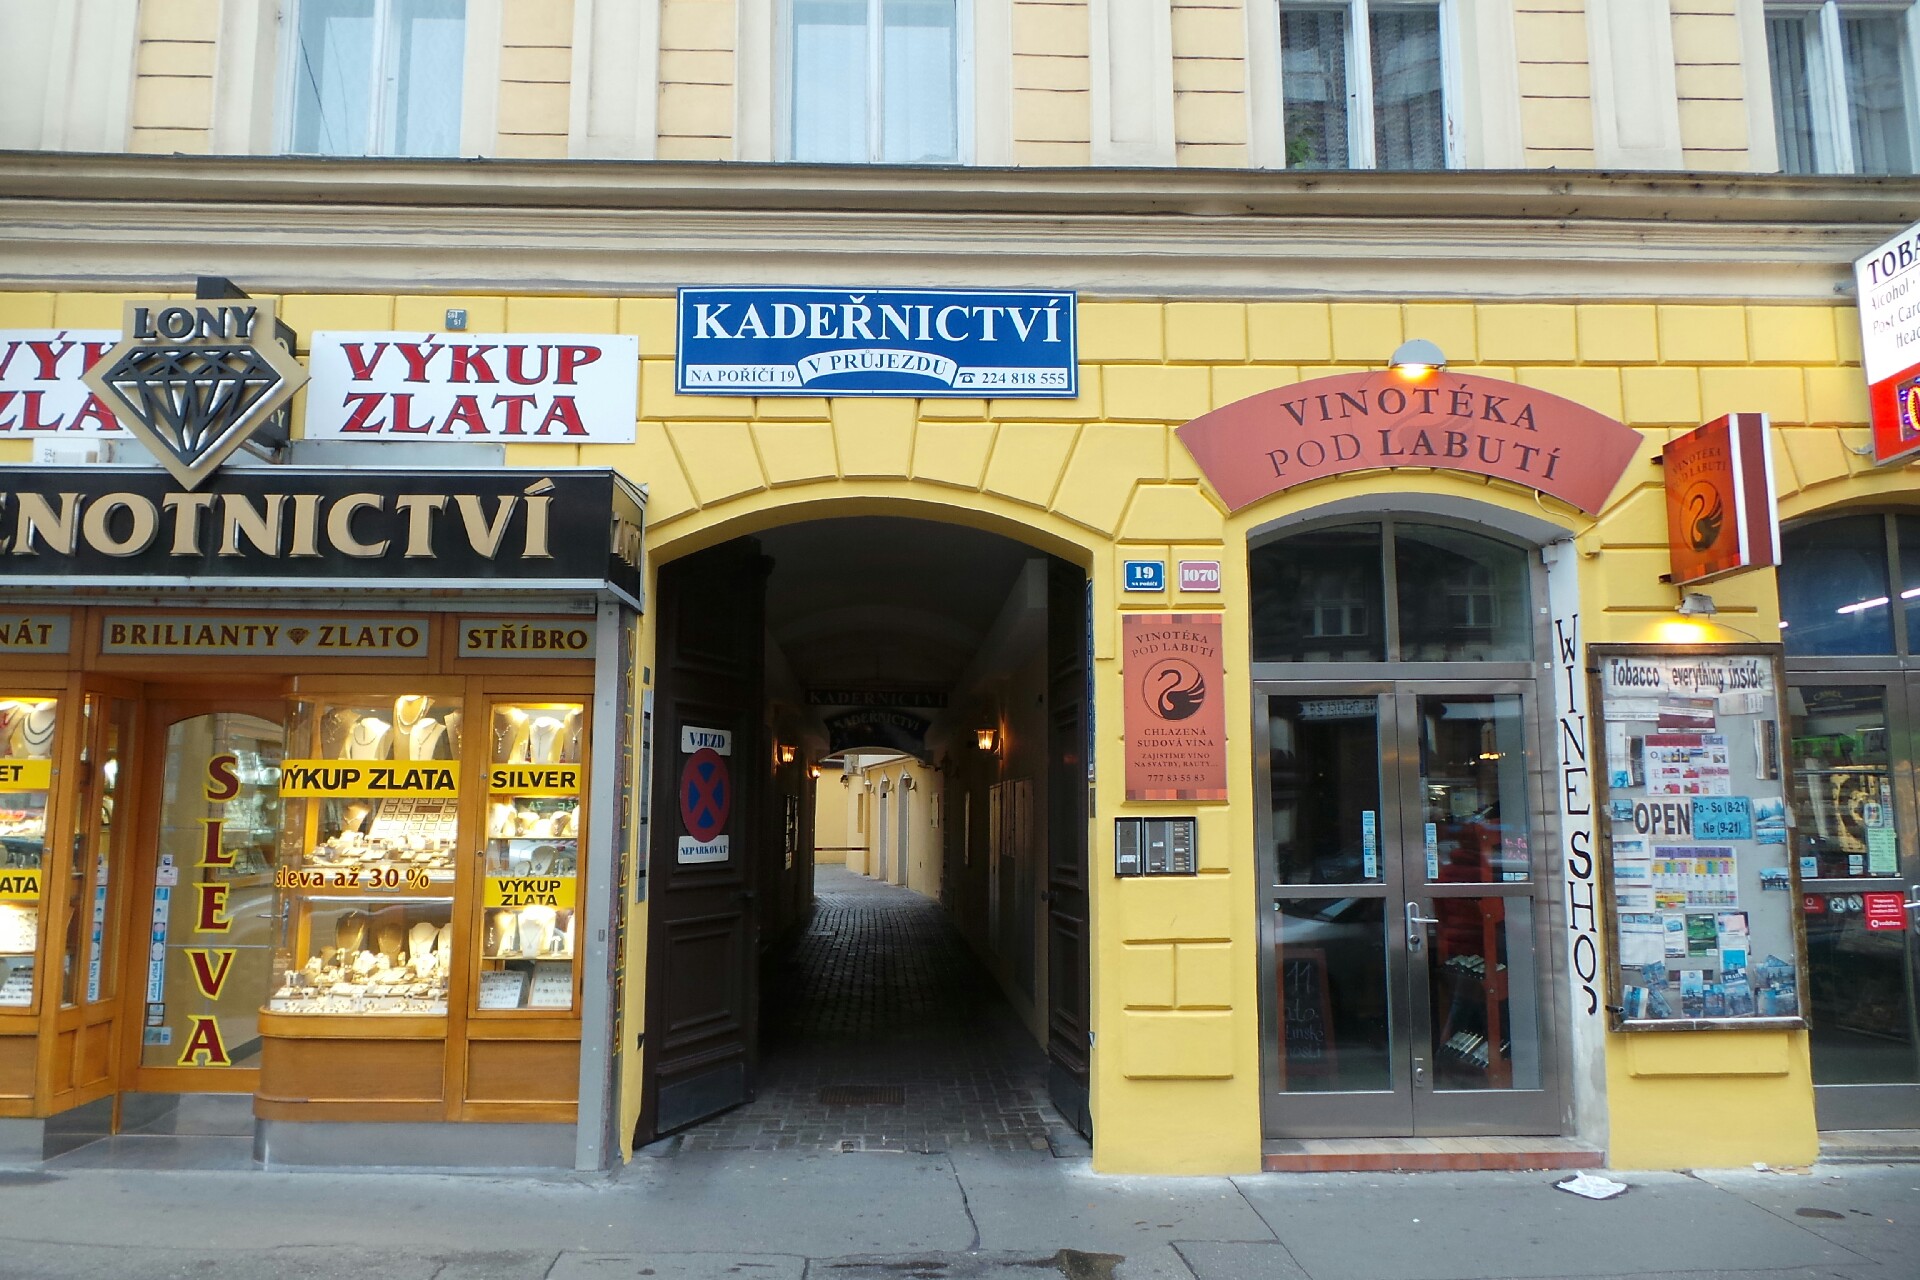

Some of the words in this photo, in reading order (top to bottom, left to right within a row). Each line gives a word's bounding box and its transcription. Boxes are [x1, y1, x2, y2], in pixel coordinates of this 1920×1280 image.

[1871, 277, 1909, 310] Alcohol
[133, 306, 258, 340] LONY
[693, 295, 1061, 342] KADEŘNICTVÍ
[341, 333, 602, 385] VÝKUP
[807, 358, 821, 374] V
[831, 349, 948, 376] PRŮJEZDU
[691, 370, 713, 382] NA
[718, 367, 775, 383] POŘÍČÍ
[780, 370, 795, 383] 19
[982, 372, 1007, 385] 224
[1011, 372, 1036, 385] 818
[1040, 373, 1065, 386] 555
[341, 392, 591, 435] ZLATA
[1281, 383, 1539, 433] VINOTÉKA
[1265, 432, 1361, 478] POD
[1379, 429, 1561, 482] LABUTÍ
[1134, 566, 1154, 579] 19
[1183, 569, 1218, 582] 1070
[110, 623, 280, 648] BRILIANTY
[317, 625, 420, 649] ZLATO
[467, 616, 589, 650] STŘÍBRO
[1136, 629, 1208, 644] VINOTÉKA
[1132, 644, 1158, 658] POD
[1163, 643, 1215, 658] LABUTÍ
[1611, 658, 1661, 687] Tobacco
[1671, 661, 1724, 692] everything
[689, 732, 725, 749] VJEZD
[1144, 726, 1207, 736] CHLAZENÁ
[1137, 738, 1182, 747] SUDOVÁ
[1186, 738, 1215, 747] VÍNA
[367, 768, 456, 791] ZLATA
[491, 770, 576, 789] SILVER
[1147, 774, 1164, 782] 777
[1180, 774, 1191, 782] 55
[1693, 802, 1704, 813] Po
[1710, 801, 1722, 813] So
[1634, 802, 1691, 835] OPEN
[1703, 822, 1715, 834] Ne
[1717, 821, 1741, 836] (9-21)
[681, 844, 728, 856] NEPARKOVAT
[276, 866, 325, 888] sleva
[333, 867, 359, 887] až
[368, 868, 399, 888] 30
[406, 868, 430, 888] %
[498, 878, 561, 893] VÝKUP
[177, 753, 241, 1067] SLEVA
[500, 894, 558, 907] ZLATA
